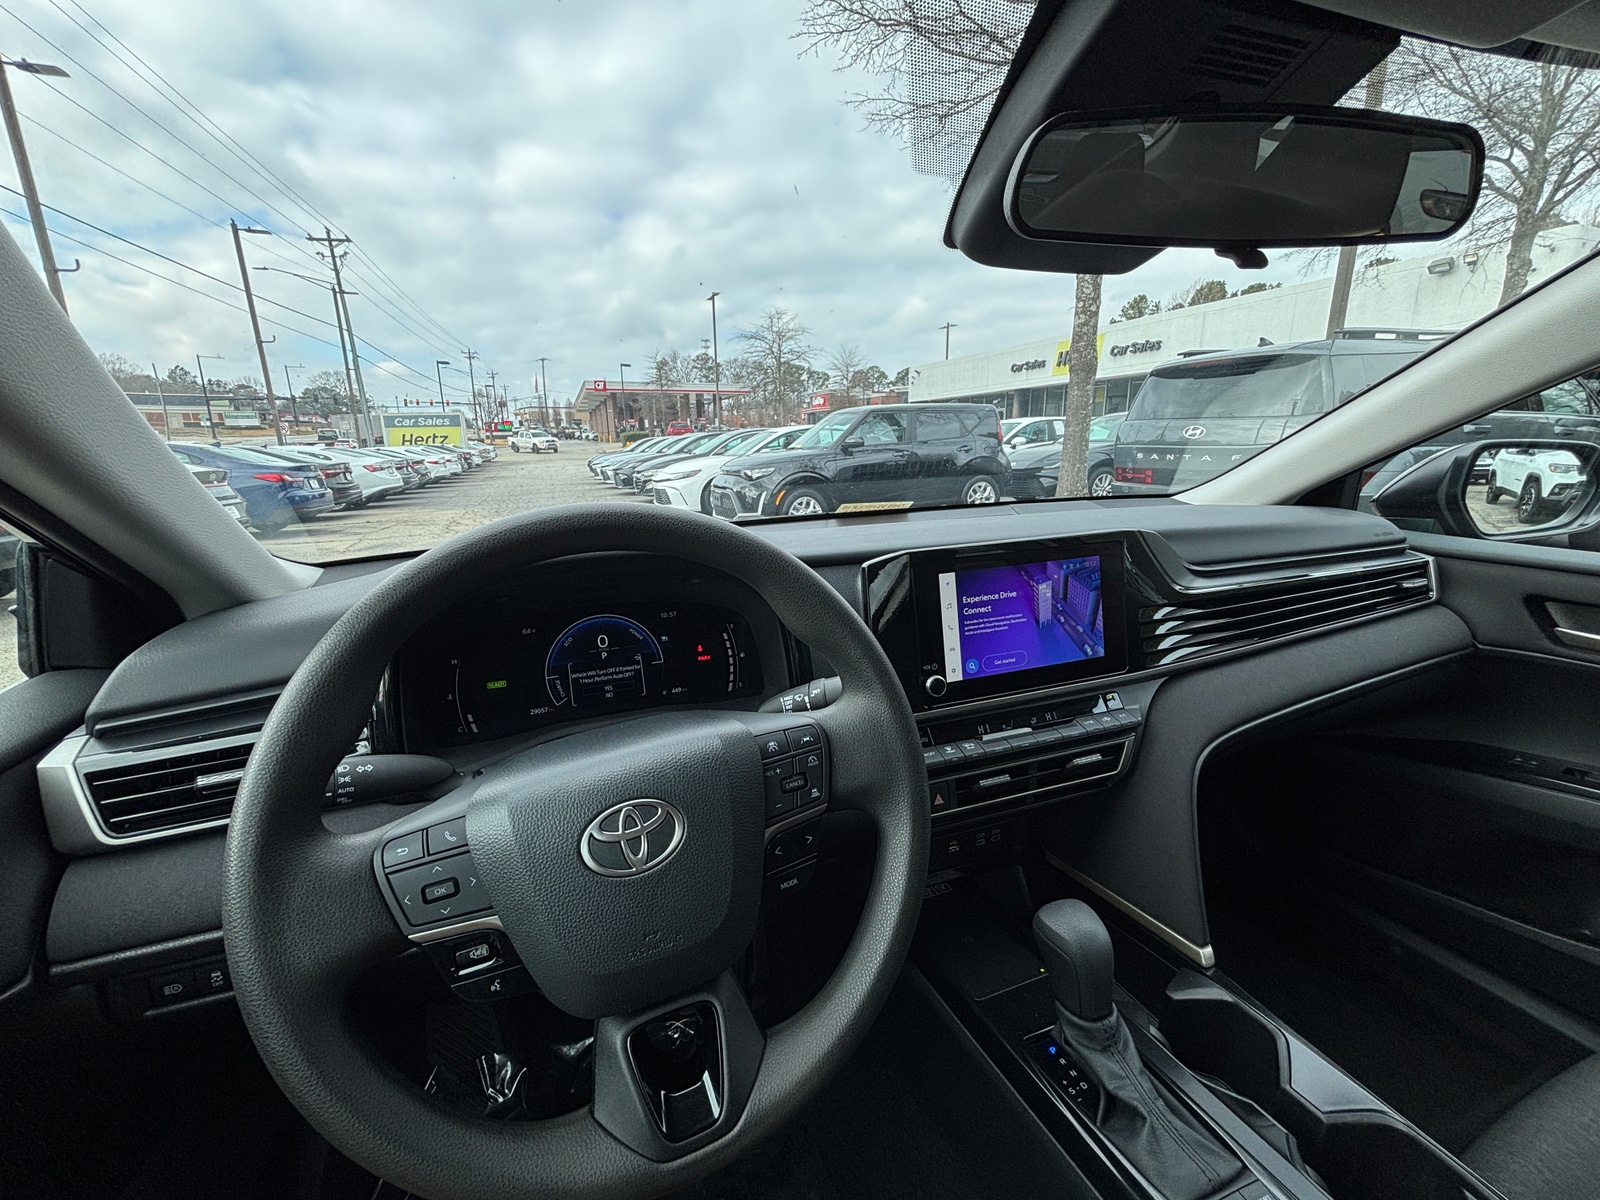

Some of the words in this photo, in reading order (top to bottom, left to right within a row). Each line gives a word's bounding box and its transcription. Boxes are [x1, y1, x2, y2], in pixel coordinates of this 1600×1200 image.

[1110, 344, 1129, 357] Car
[1129, 340, 1162, 354] Sales
[1011, 363, 1023, 373] Car
[1023, 358, 1046, 371] Sales
[595, 381, 605, 390] QT
[394, 417, 415, 426] Car
[418, 416, 450, 426] Sales
[401, 433, 449, 446] Hertz
[1136, 453, 1212, 461] SANTA
[962, 593, 999, 604] Experience
[1000, 590, 1017, 599] Drive
[963, 605, 992, 615] Connect
[597, 634, 609, 648] 0
[601, 651, 608, 660] P
[530, 707, 549, 715] 29057
[1045, 711, 1058, 721] HI
[977, 723, 990, 734] HI
[785, 780, 804, 790] CANCEL
[780, 877, 799, 890] MODE
[434, 886, 446, 896] OK
[648, 934, 684, 955] AIRBAG
[1049, 1046, 1056, 1054] P
[1069, 1069, 1078, 1077] N
[1080, 1081, 1088, 1090] D
[1068, 1087, 1076, 1095] S
